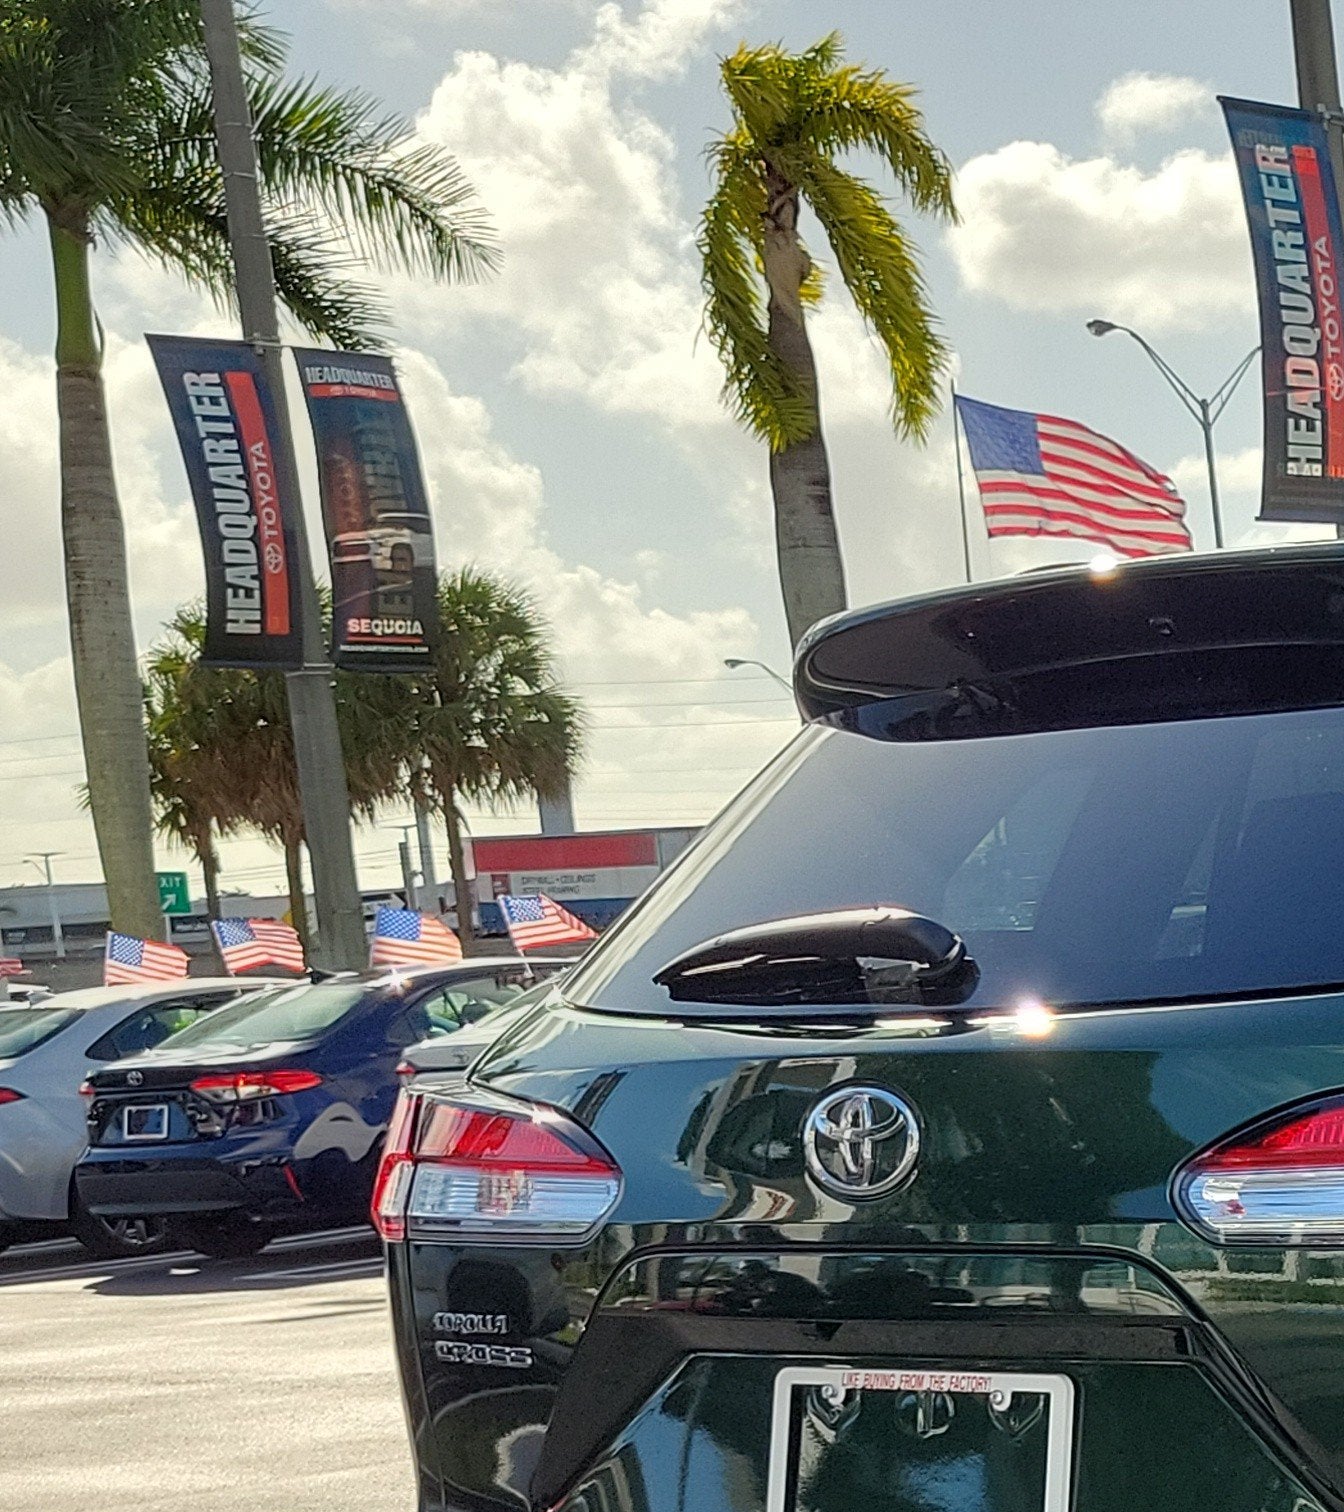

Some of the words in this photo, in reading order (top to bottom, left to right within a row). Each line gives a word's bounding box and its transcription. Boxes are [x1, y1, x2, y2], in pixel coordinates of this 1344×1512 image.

[1255, 143, 1322, 477] HEADQUARTER
[1311, 236, 1344, 359] TOYOTA
[304, 366, 396, 390] HEADQUARTER
[183, 370, 262, 636] HEADQUARTER
[250, 441, 280, 539] TOYOTA
[347, 618, 424, 636] SEQUOIA
[160, 876, 181, 888] XIT
[435, 1340, 533, 1368] CROSS
[842, 1372, 860, 1387] LIKE
[863, 1373, 896, 1389] BUYING
[899, 1374, 925, 1389] FROM
[929, 1375, 946, 1390] THE
